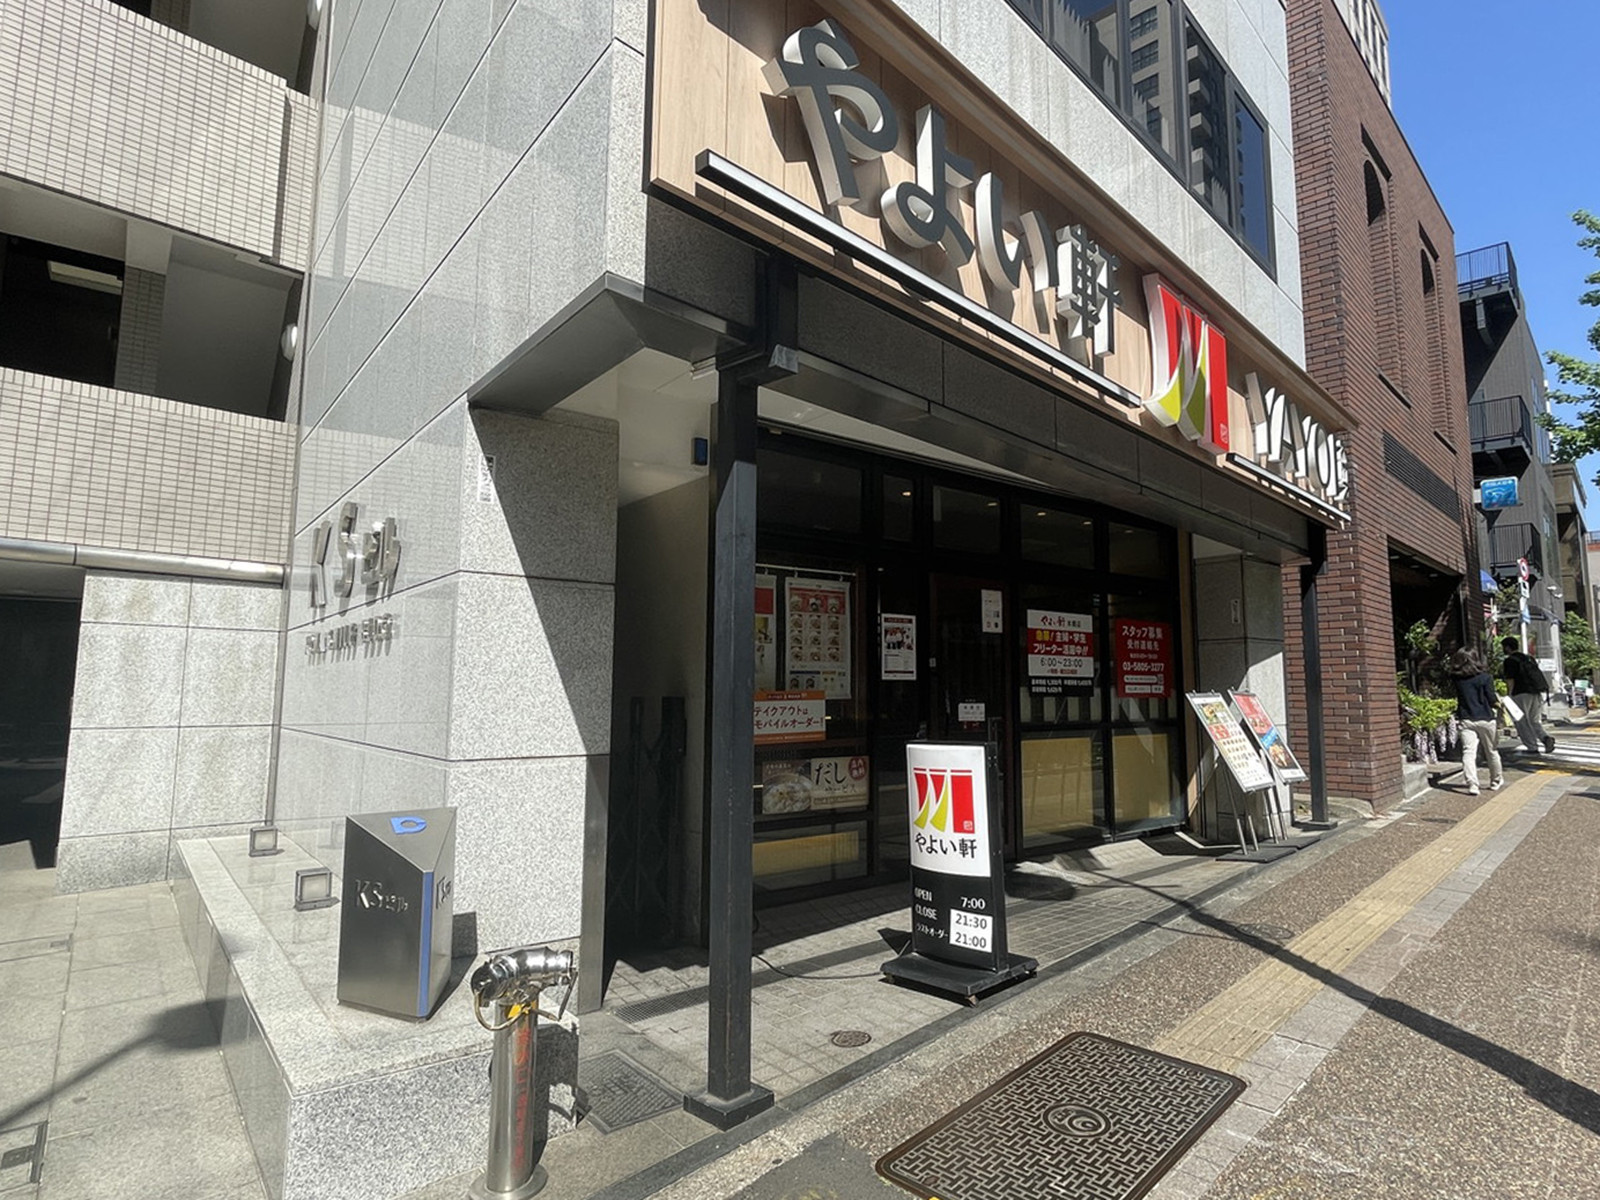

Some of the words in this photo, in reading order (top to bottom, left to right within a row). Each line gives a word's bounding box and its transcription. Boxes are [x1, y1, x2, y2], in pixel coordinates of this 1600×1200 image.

[762, 18, 1121, 357] やよい軒
[754, 705, 808, 717] テイクアウトは
[815, 762, 847, 785] だし
[915, 832, 977, 859] やよい軒
[914, 887, 933, 902] OPEN
[960, 896, 986, 910] 7:00
[915, 903, 938, 920] CLOSE
[955, 912, 988, 930] 21:30
[955, 931, 987, 949] 21:00
